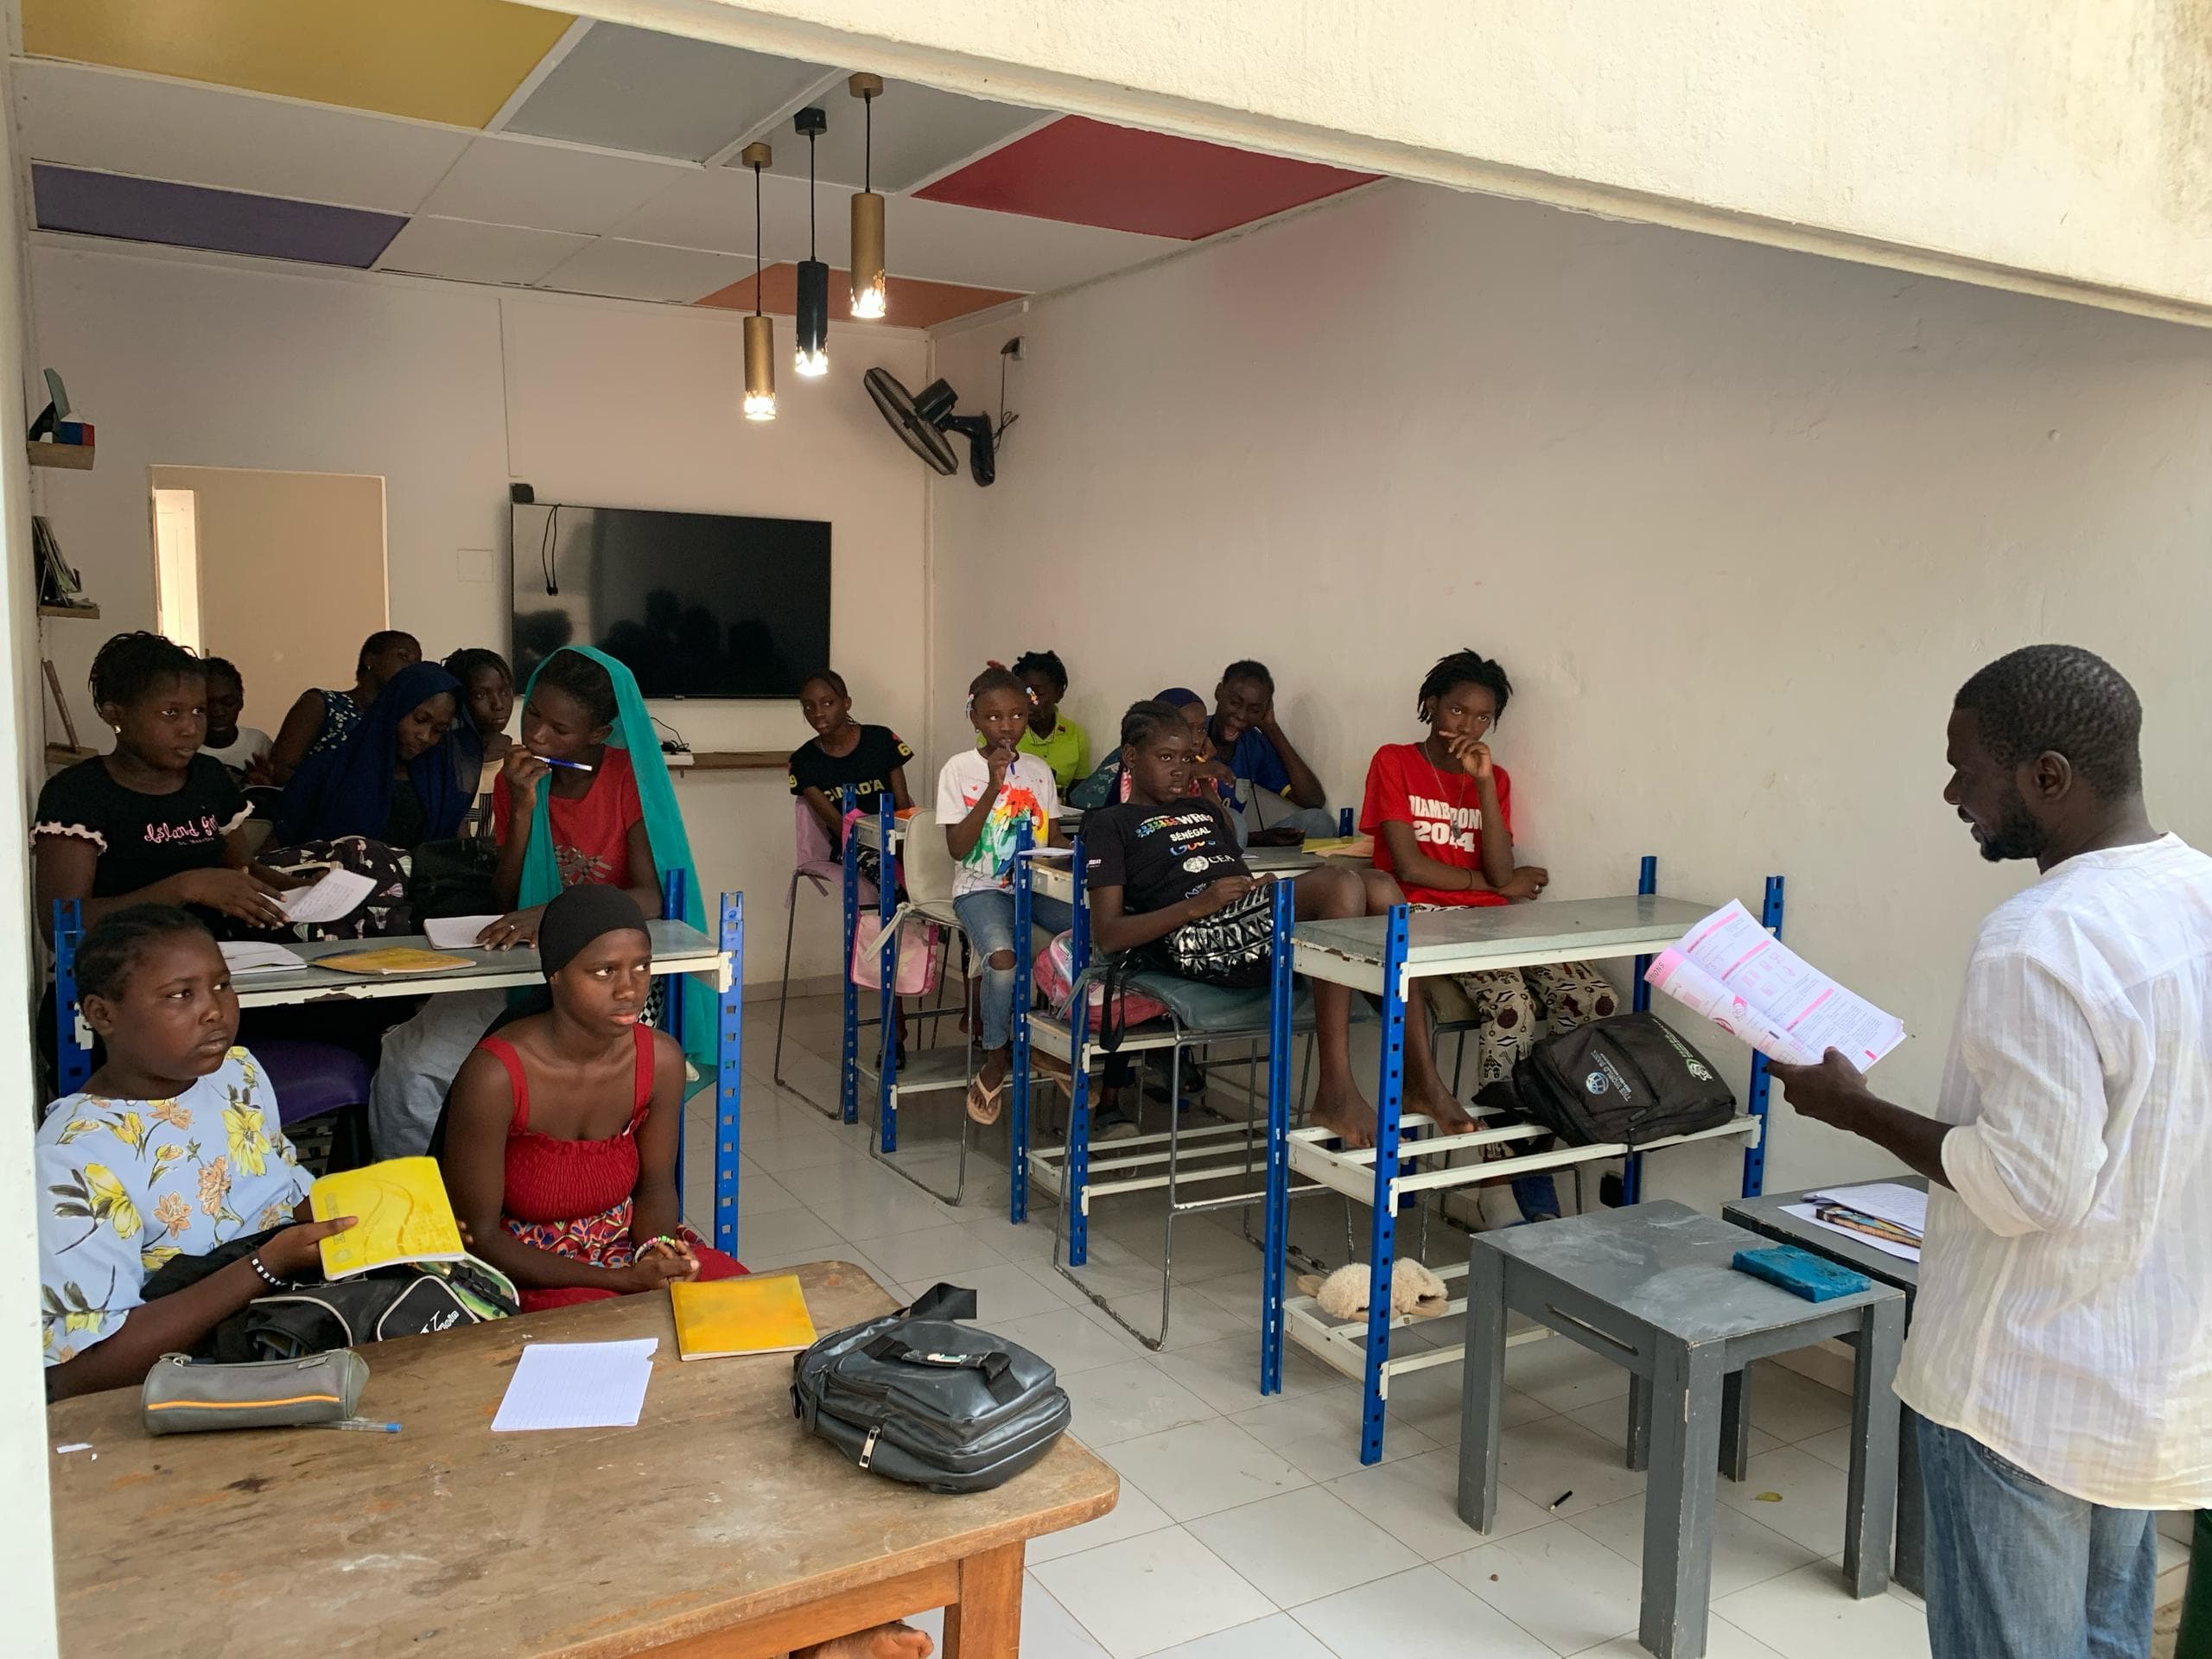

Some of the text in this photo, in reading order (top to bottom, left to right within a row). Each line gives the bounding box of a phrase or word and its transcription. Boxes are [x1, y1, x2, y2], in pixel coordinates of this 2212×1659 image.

[823, 779, 885, 803] CNDA
[143, 820, 200, 844] Island
[1169, 826, 1211, 842] SÉNÉGAL
[1601, 1065, 1623, 1090] WORLD
